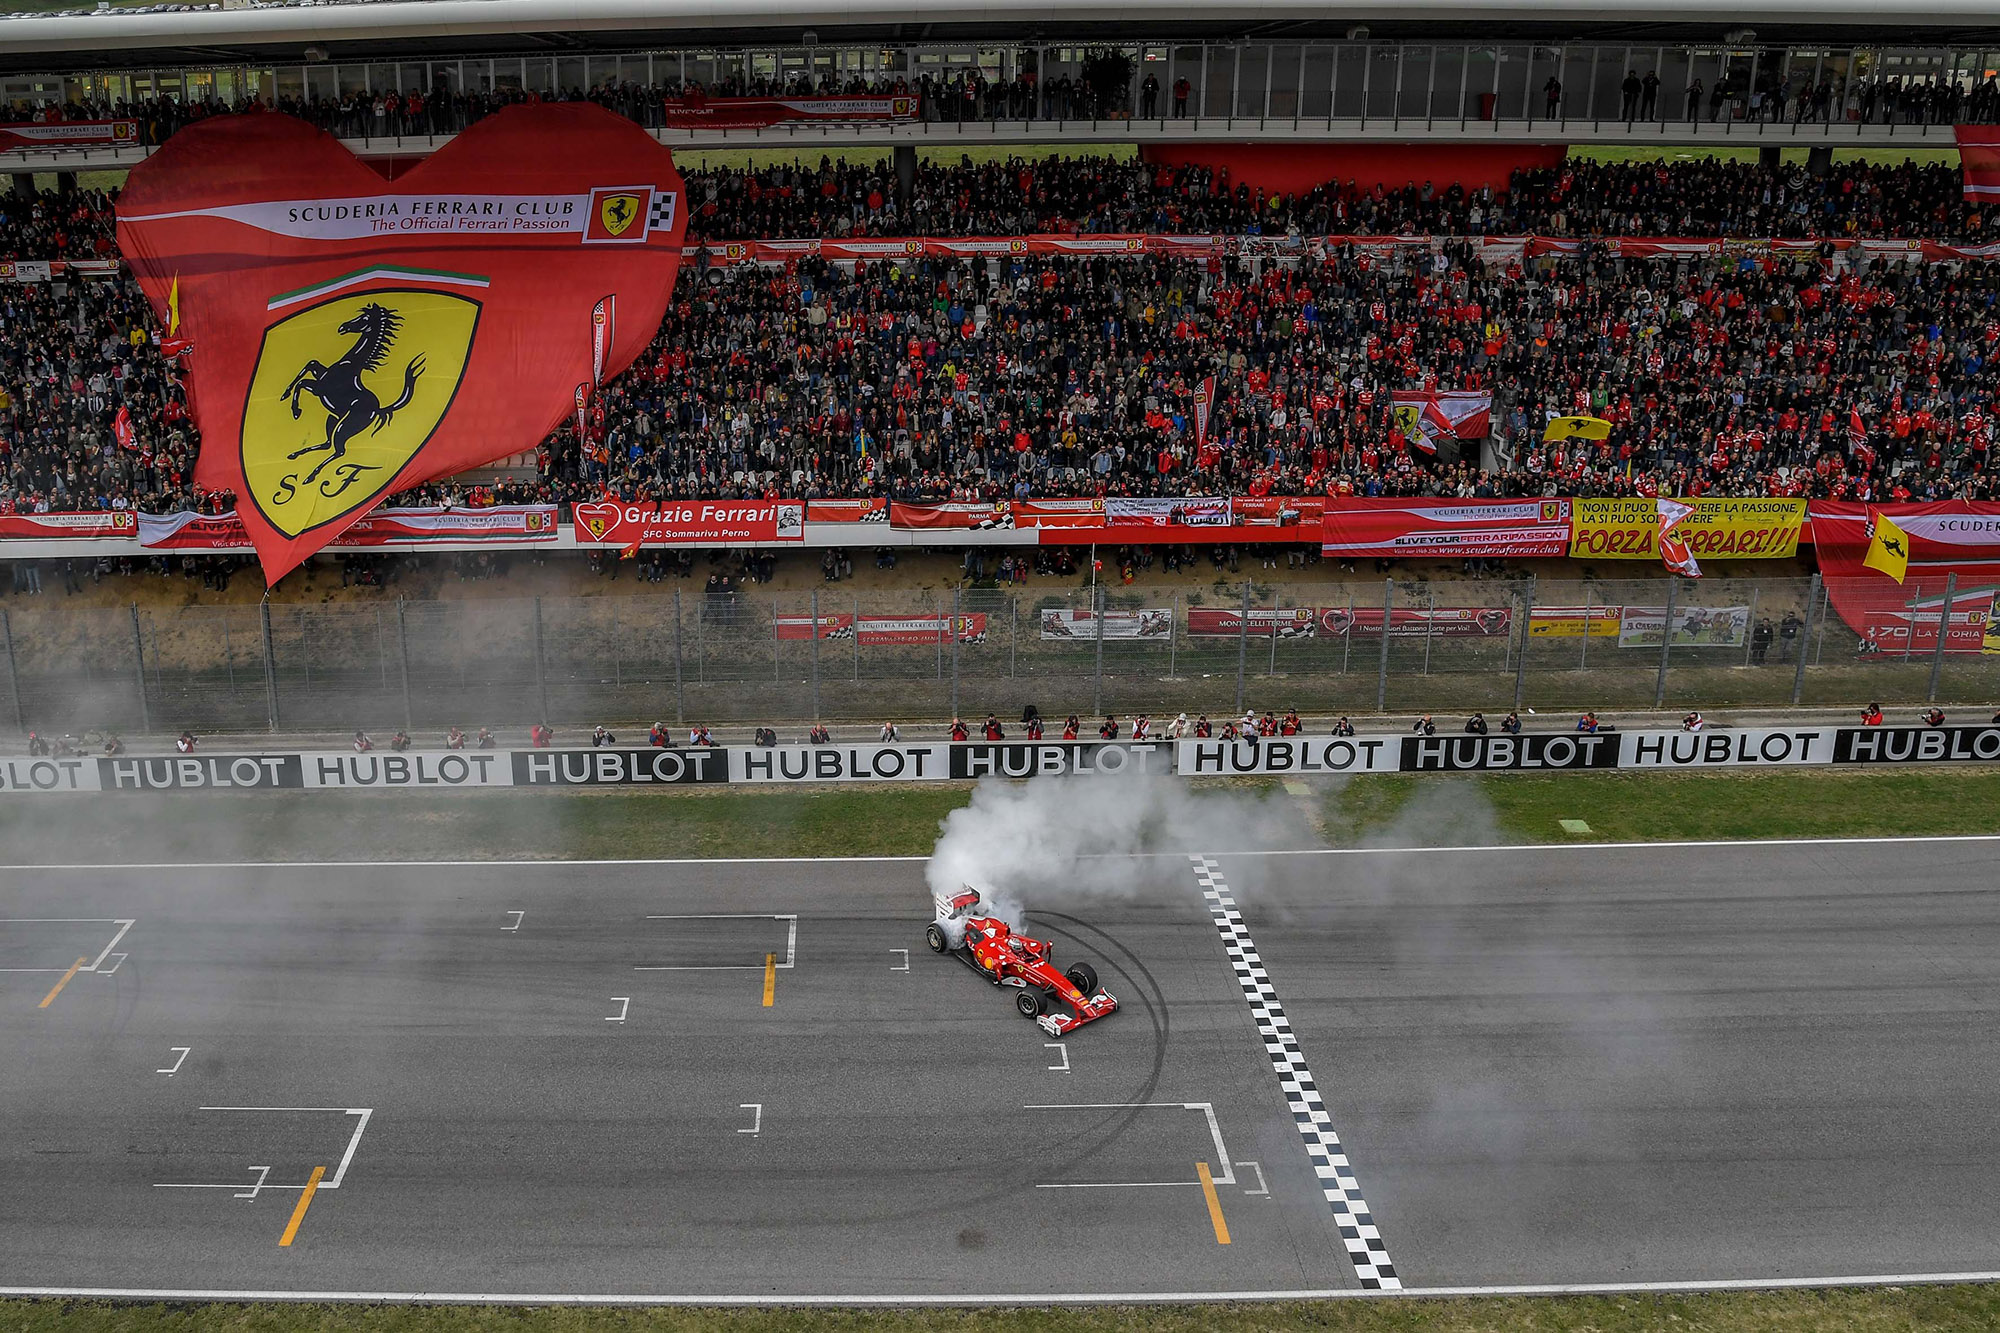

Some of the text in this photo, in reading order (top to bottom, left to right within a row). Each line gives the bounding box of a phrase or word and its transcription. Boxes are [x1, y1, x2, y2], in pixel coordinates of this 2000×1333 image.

[289, 201, 574, 222] SCUDERIA FERRARI CLUB
[370, 216, 570, 231] The Official Ferrari Passion
[273, 464, 383, 505] S F
[624, 504, 776, 524] Grazie Ferrari
[1434, 504, 1535, 516] SCUDERIA FERRARI CLUB
[1579, 503, 1610, 513] "NON
[1612, 503, 1622, 513] SI
[1625, 503, 1652, 513] PUO'
[1725, 503, 1739, 513] LA
[1741, 503, 1798, 514] PASSIONE,
[1582, 514, 1596, 524] LA
[1598, 514, 1607, 524] SI
[1610, 514, 1638, 524] PUO'
[212, 540, 228, 548] Visit
[642, 529, 750, 538] SFC Sommariva Perno
[1395, 531, 1562, 545] #LIVEYOURFERRARIPASSION
[1575, 527, 1798, 554] FORZA ERRARI!!!
[1439, 545, 1560, 556] www.scuderiaferrari.club
[1878, 626, 1909, 637] 70
[1917, 629, 1932, 637] LA
[1195, 740, 1384, 772] HUBLOT
[1416, 736, 1604, 769] HUBLOT
[1634, 732, 1820, 764] HUBLOT
[317, 755, 494, 785] HUBLOT
[527, 752, 711, 784] HUBLOT
[744, 748, 932, 781] HUBLOT
[966, 745, 1156, 777] HUBLOT
[0, 761, 82, 790] LOT
[112, 757, 285, 789] HUBLOT
